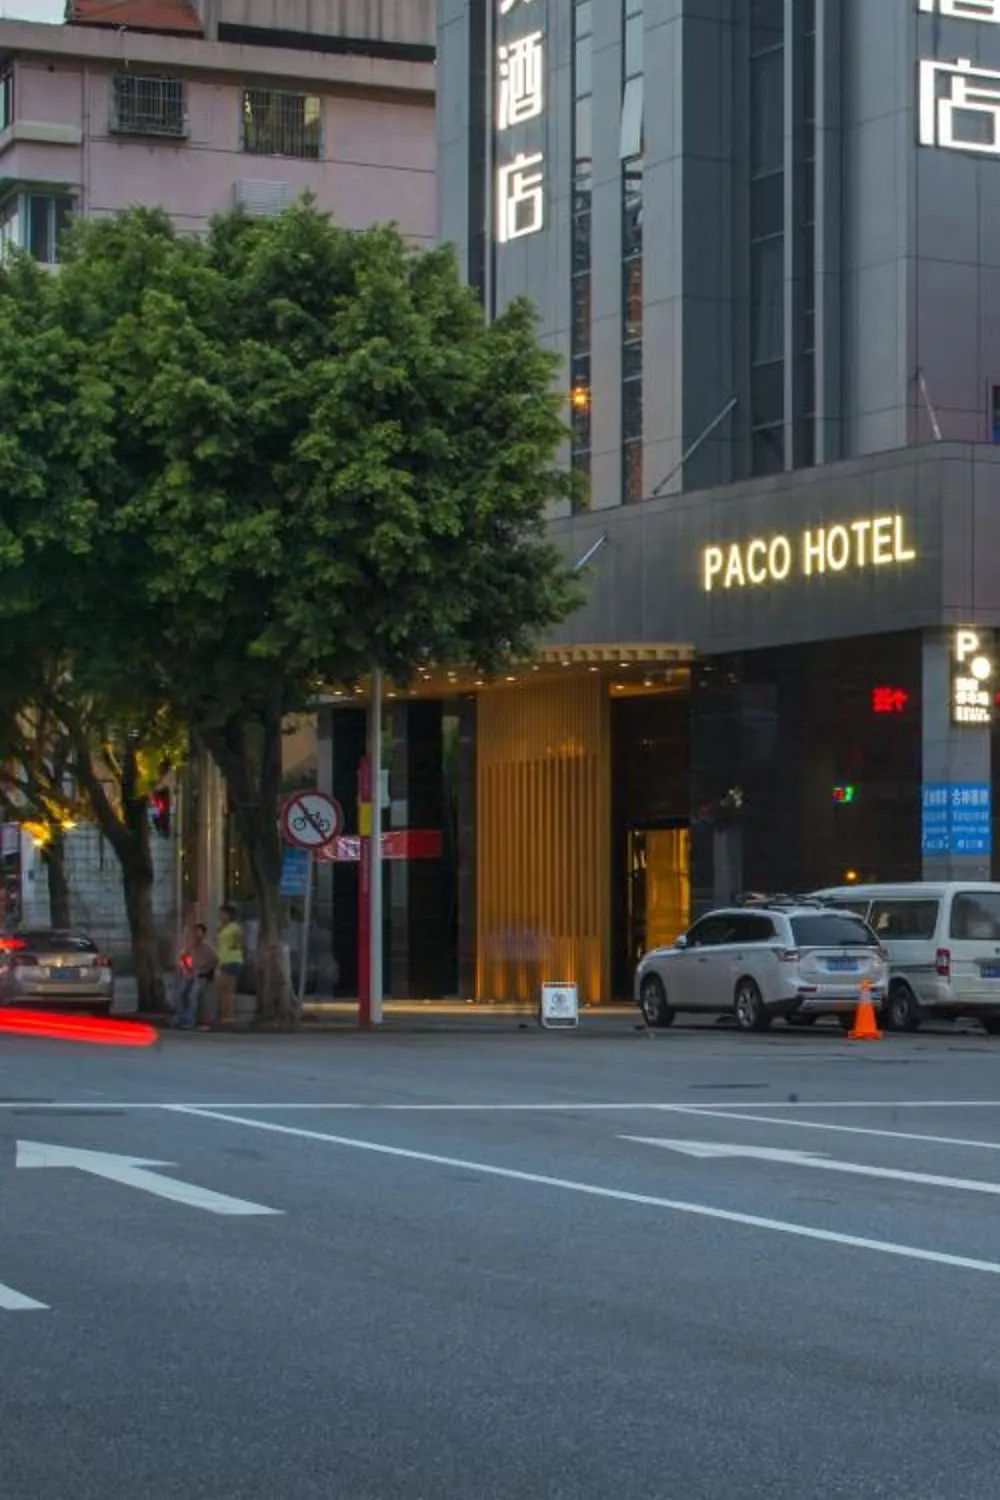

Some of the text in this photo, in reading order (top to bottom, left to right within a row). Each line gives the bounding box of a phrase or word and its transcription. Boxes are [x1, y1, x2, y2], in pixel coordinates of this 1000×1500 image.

[702, 514, 916, 591] PACO HOTEL
[956, 630, 979, 662] P
